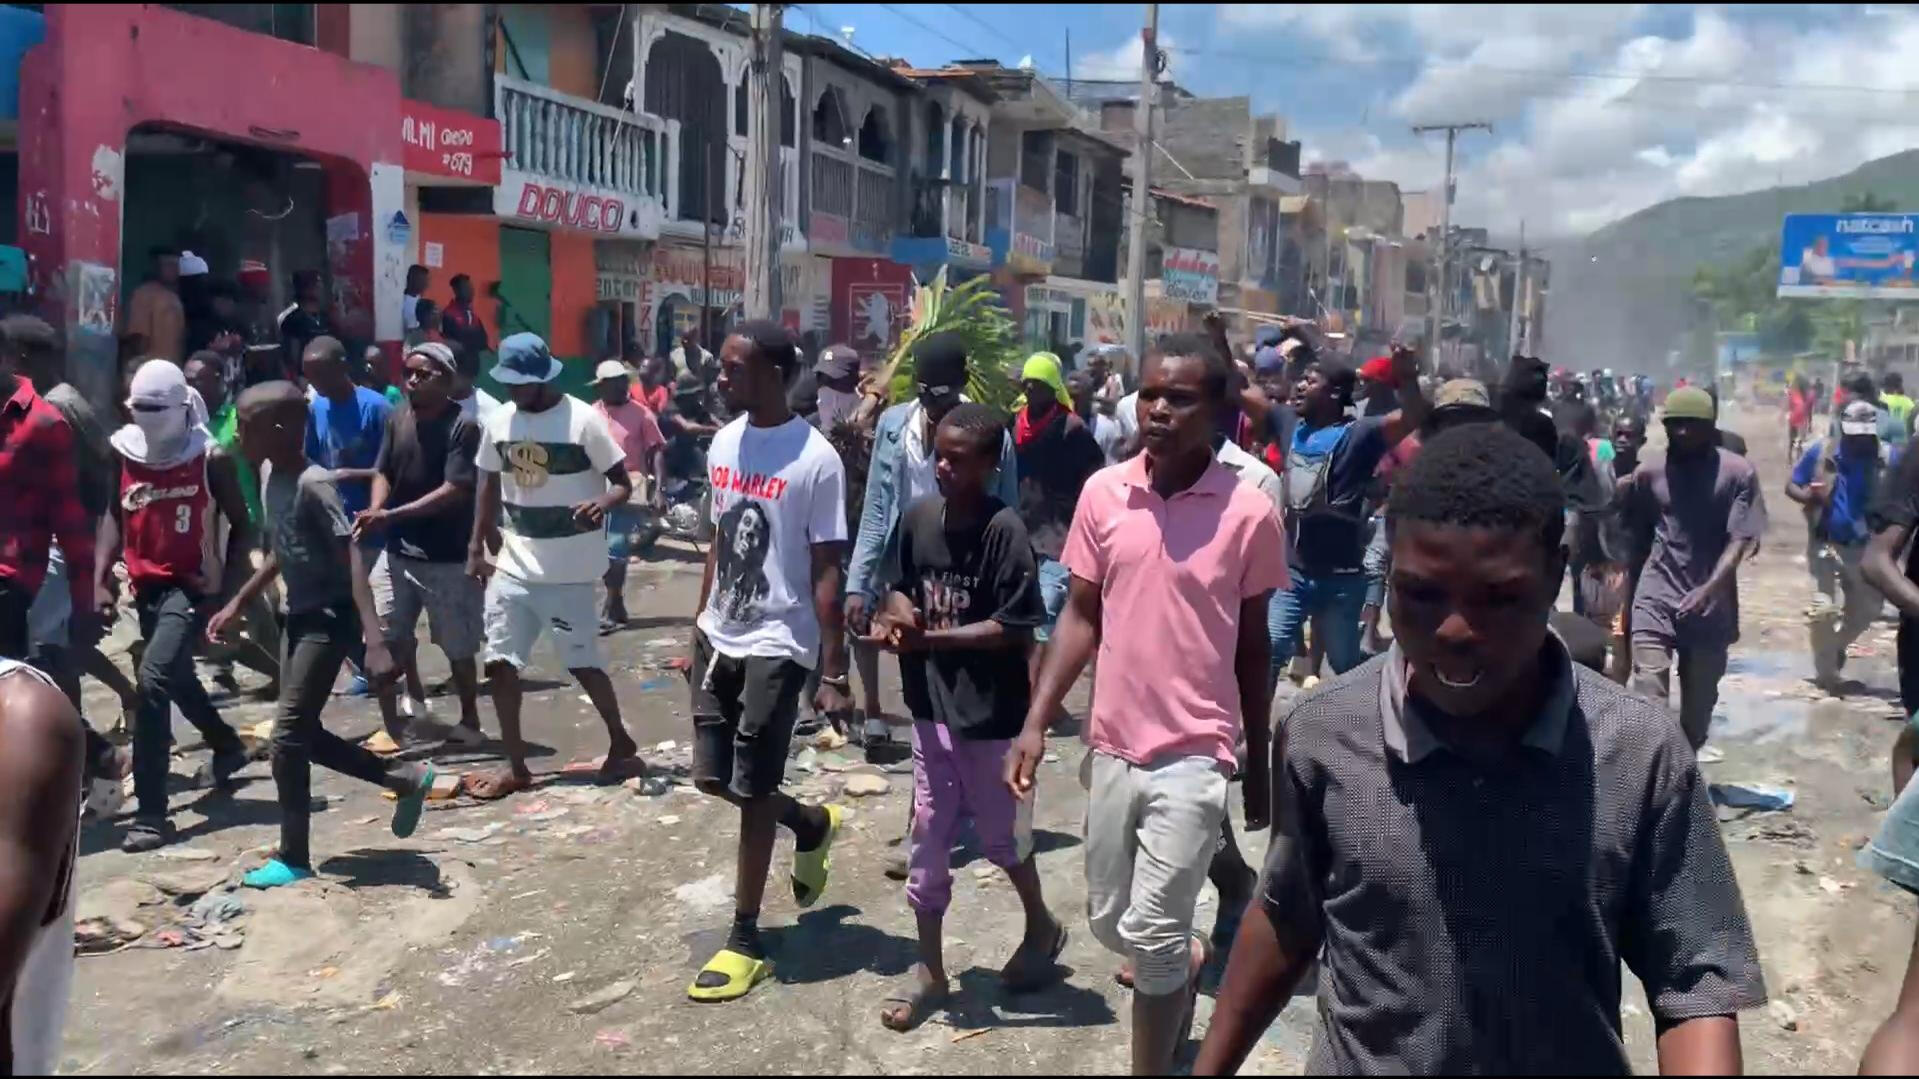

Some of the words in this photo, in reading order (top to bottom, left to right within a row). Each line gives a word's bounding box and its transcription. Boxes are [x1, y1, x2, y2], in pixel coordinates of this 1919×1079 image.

[518, 184, 623, 231] DOUCO
[731, 468, 788, 500] MARLEY
[175, 504, 191, 533] 3
